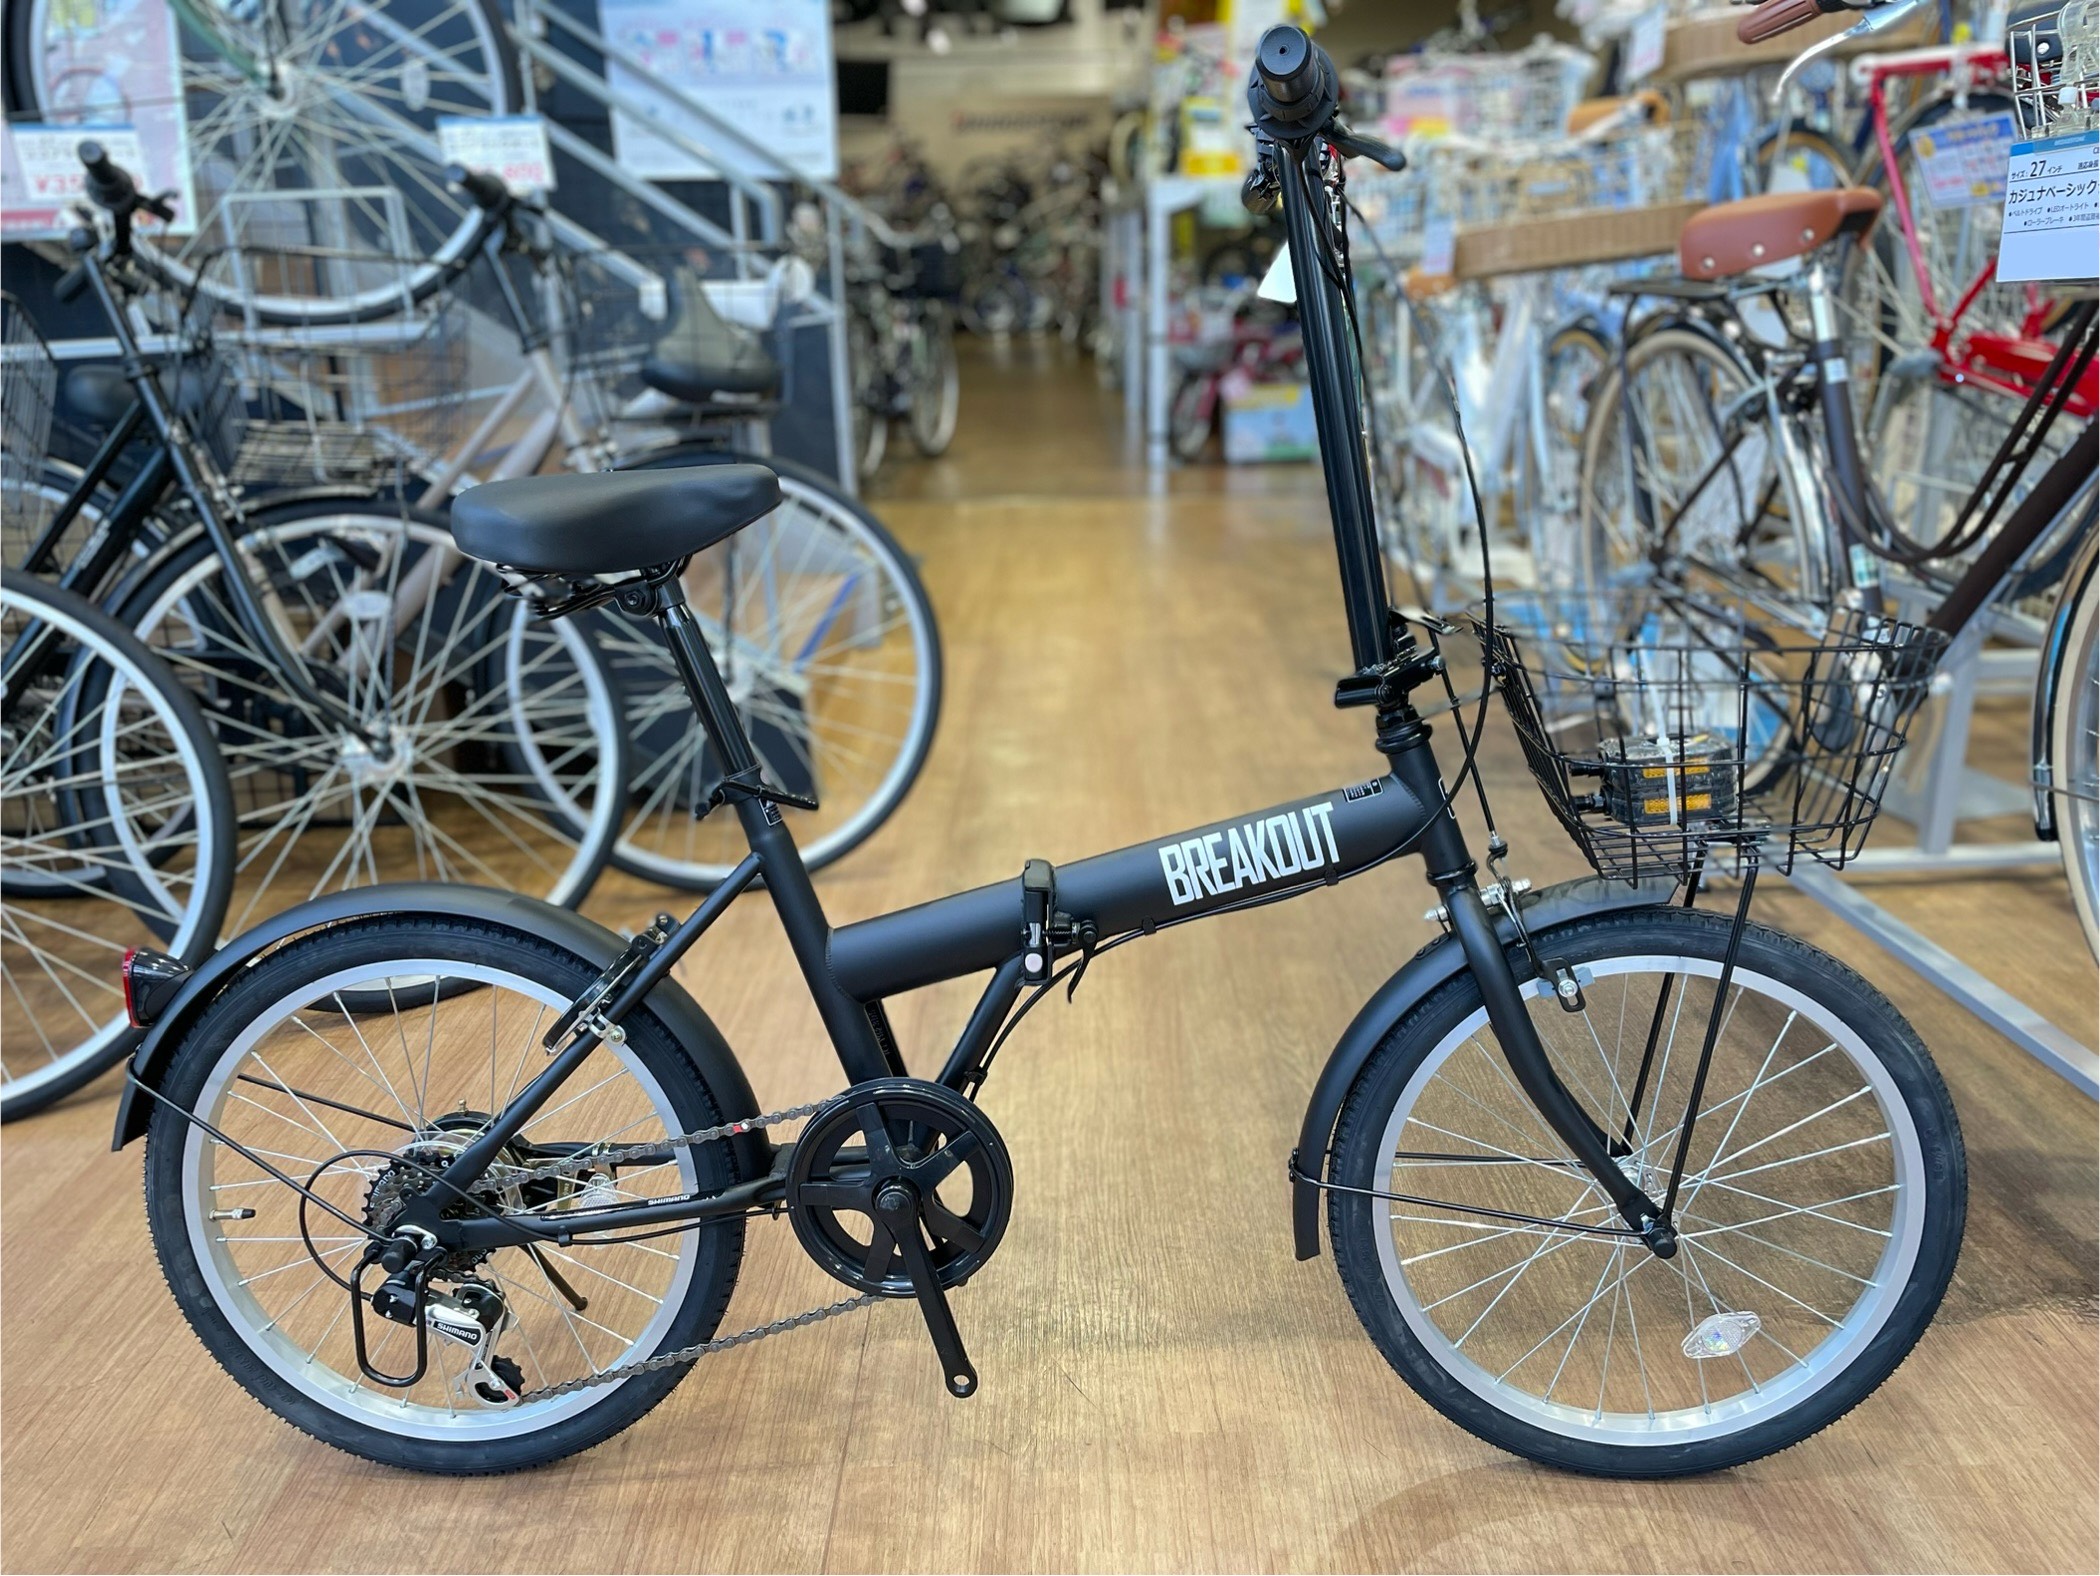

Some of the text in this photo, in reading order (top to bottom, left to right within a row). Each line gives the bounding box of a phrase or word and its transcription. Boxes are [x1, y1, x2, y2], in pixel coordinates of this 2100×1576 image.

[2030, 160, 2047, 177] 27
[2047, 165, 2063, 175] インチ
[2008, 179, 2099, 204] カジュナベーシック
[1158, 801, 1340, 906] BREAKOUT
[647, 1194, 691, 1206] SHIMANO
[436, 1322, 478, 1340] SHIMANO
